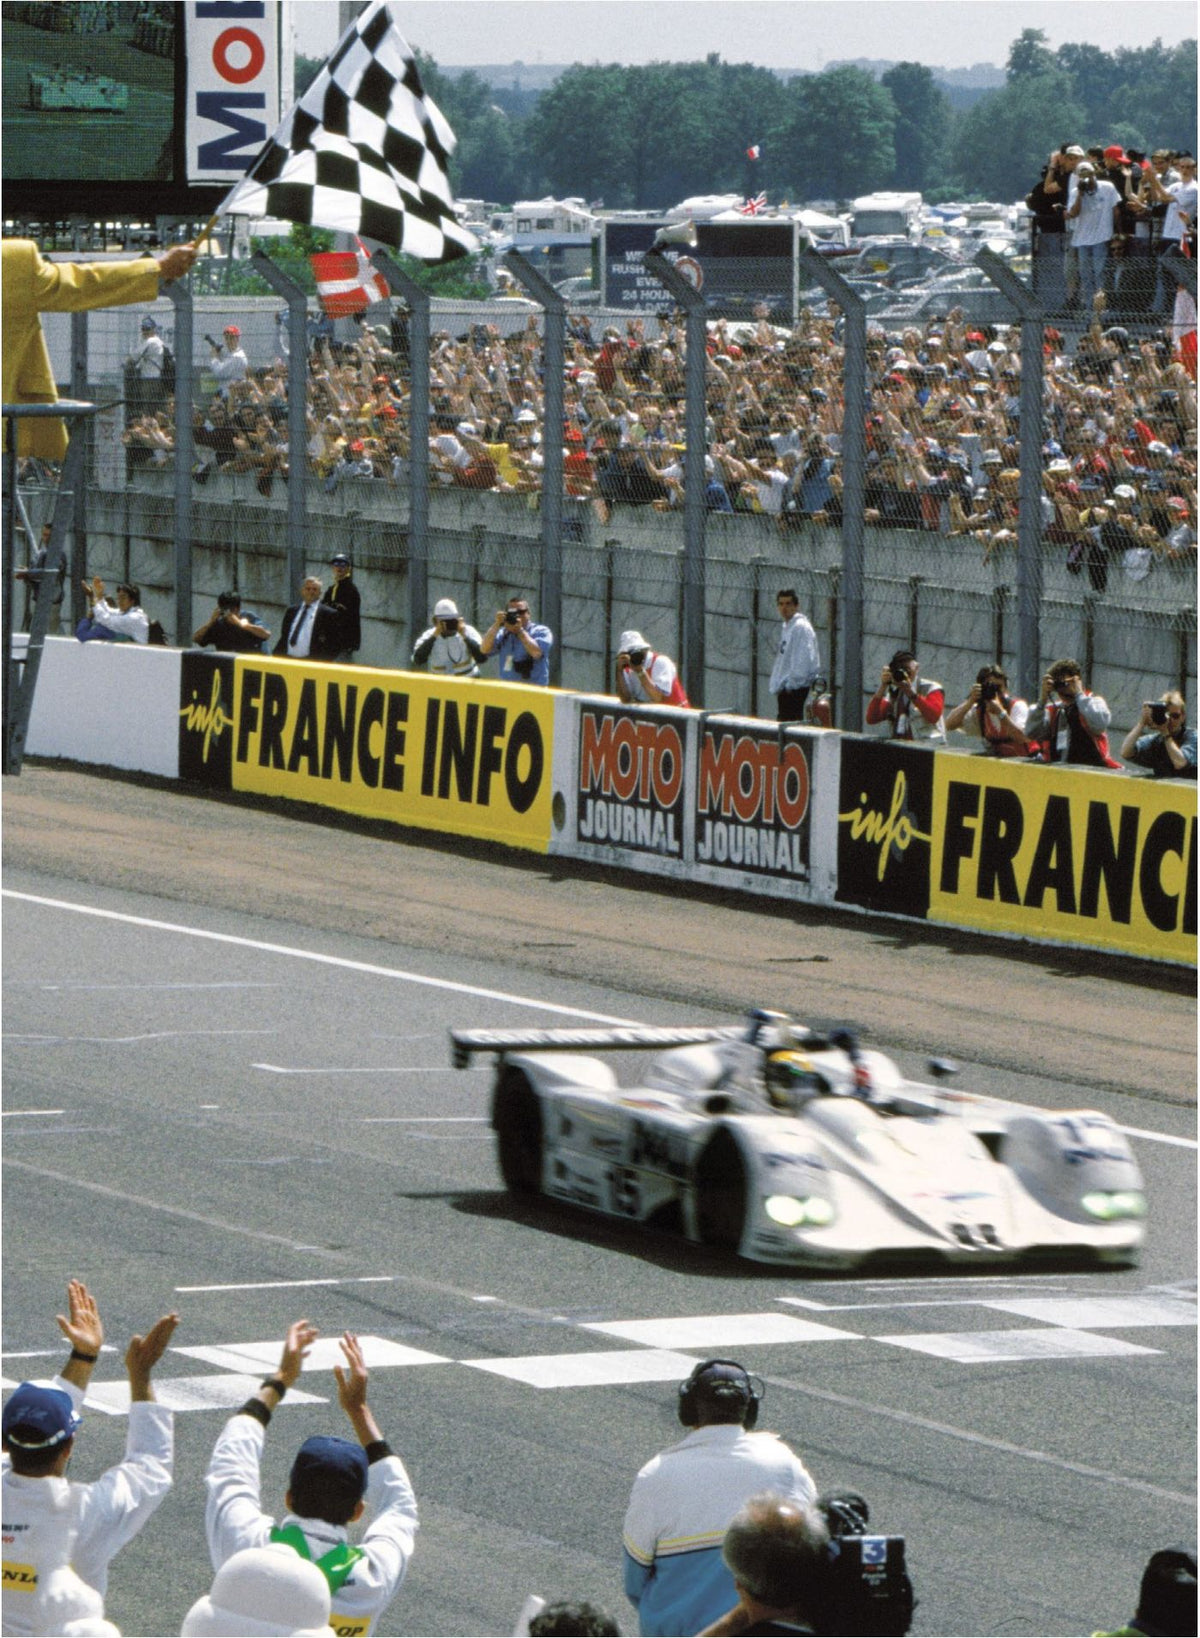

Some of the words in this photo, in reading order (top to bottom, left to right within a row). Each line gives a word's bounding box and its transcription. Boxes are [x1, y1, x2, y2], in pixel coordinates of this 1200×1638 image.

[612, 264, 645, 274] RUSH
[622, 289, 638, 300] 24
[181, 668, 234, 763] info
[236, 668, 410, 792] FRANCE
[421, 698, 544, 814] INFO
[580, 712, 683, 808] MOTO
[698, 731, 810, 829] MOTO
[580, 799, 680, 852] JOURNAL
[699, 820, 806, 873] JOURNAL
[838, 770, 931, 883] info
[864, 1539, 885, 1563] 3
